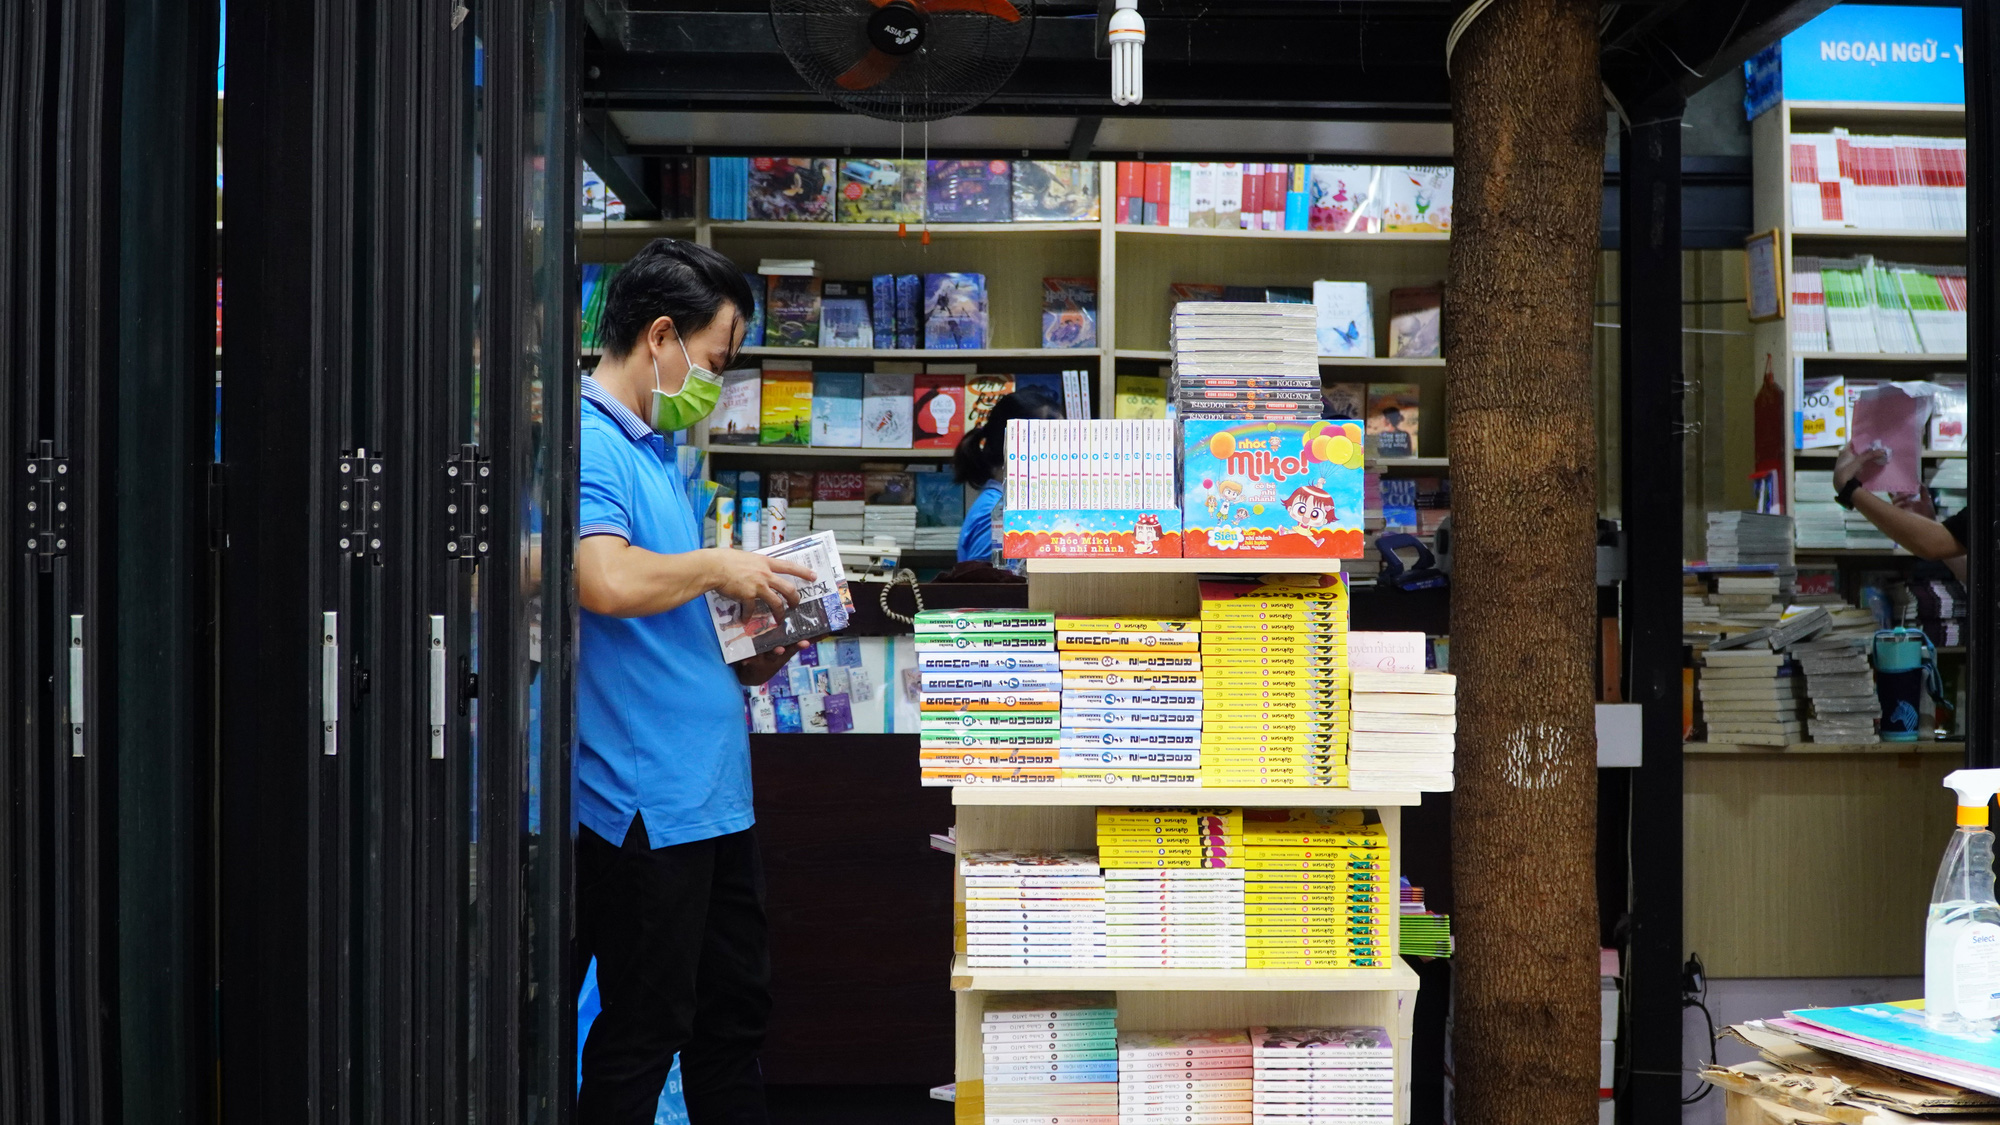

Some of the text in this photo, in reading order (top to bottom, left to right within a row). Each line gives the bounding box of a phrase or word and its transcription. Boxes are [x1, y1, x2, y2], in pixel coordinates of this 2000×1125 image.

[884, 25, 902, 37] ASIA
[1820, 42, 1887, 67] NGOẠI
[1892, 38, 1938, 63] NGỮ
[1238, 438, 1266, 449] nhóc
[1227, 451, 1309, 482] Miko!
[1214, 531, 1238, 540] Siêu
[1972, 935, 1995, 944] Select
